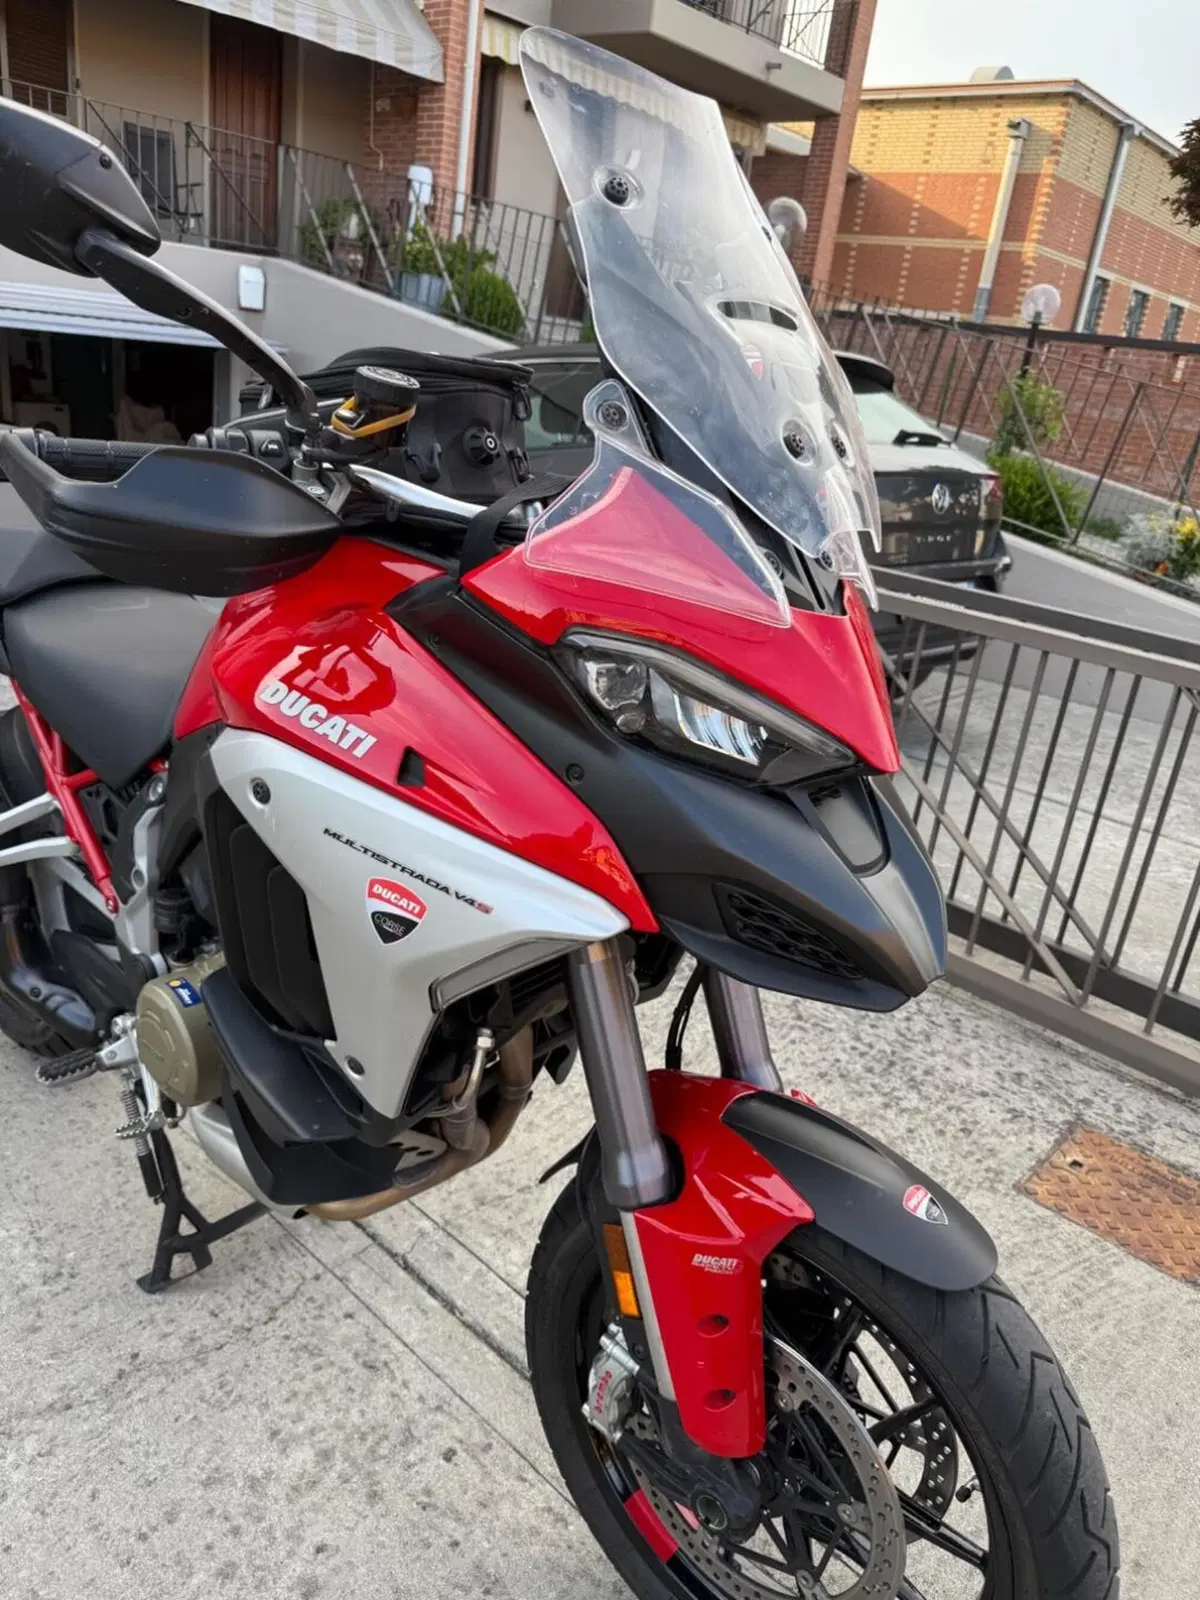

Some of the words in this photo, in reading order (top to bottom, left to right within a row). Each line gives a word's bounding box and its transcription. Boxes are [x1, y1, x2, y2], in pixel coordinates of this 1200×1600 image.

[259, 679, 377, 758] DUCATI
[323, 827, 452, 897] MULTISTRADA
[372, 884, 421, 914] DUCATI
[374, 913, 405, 934] CORSE
[691, 1253, 738, 1270] DUCATI
